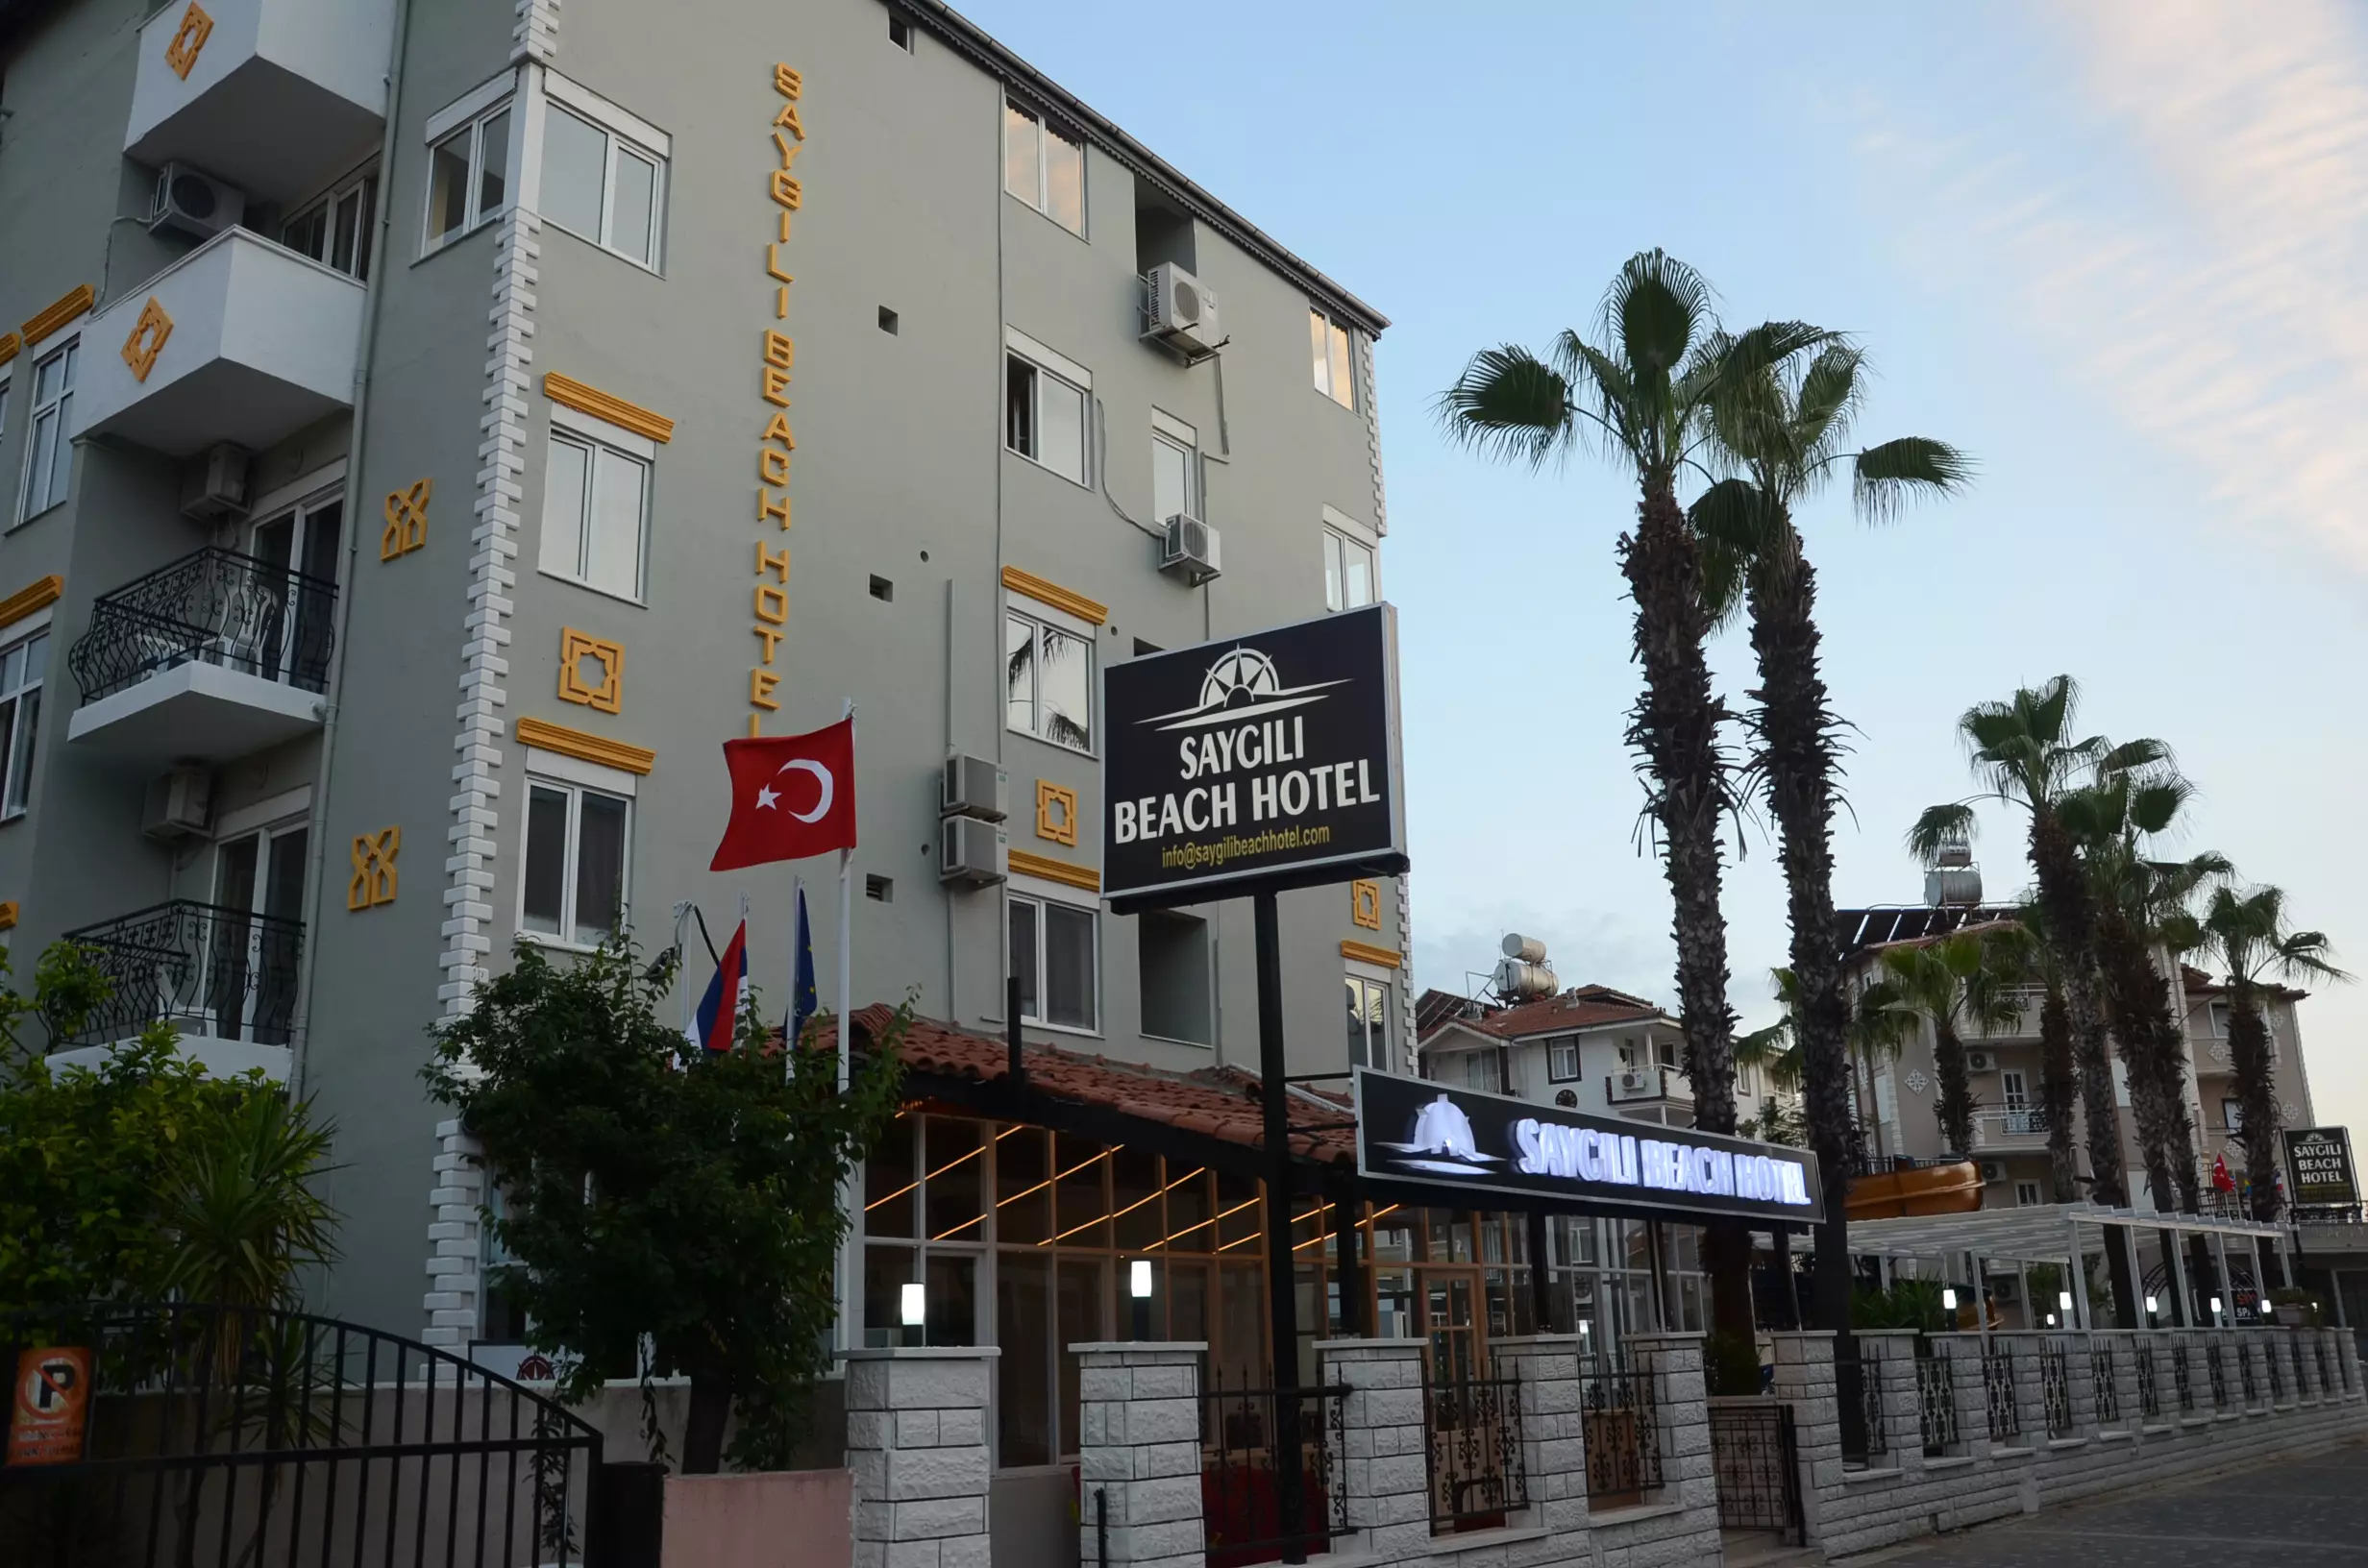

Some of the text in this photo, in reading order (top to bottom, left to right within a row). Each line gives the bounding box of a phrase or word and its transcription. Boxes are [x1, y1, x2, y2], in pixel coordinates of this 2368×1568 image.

[765, 61, 805, 320] SAYGILI
[756, 328, 797, 531] BEACH
[1179, 716, 1305, 780] SAYGILI
[1114, 758, 1381, 845] BEACH HOTEL
[1161, 824, 1331, 870] info@saygilibeachhotel.com
[1515, 1117, 1812, 1205] SAYGILI BEACH HOTEL
[2294, 1143, 2342, 1158] SAYGILI
[2298, 1158, 2342, 1171] BEACH
[2301, 1171, 2343, 1184] HOTEL
